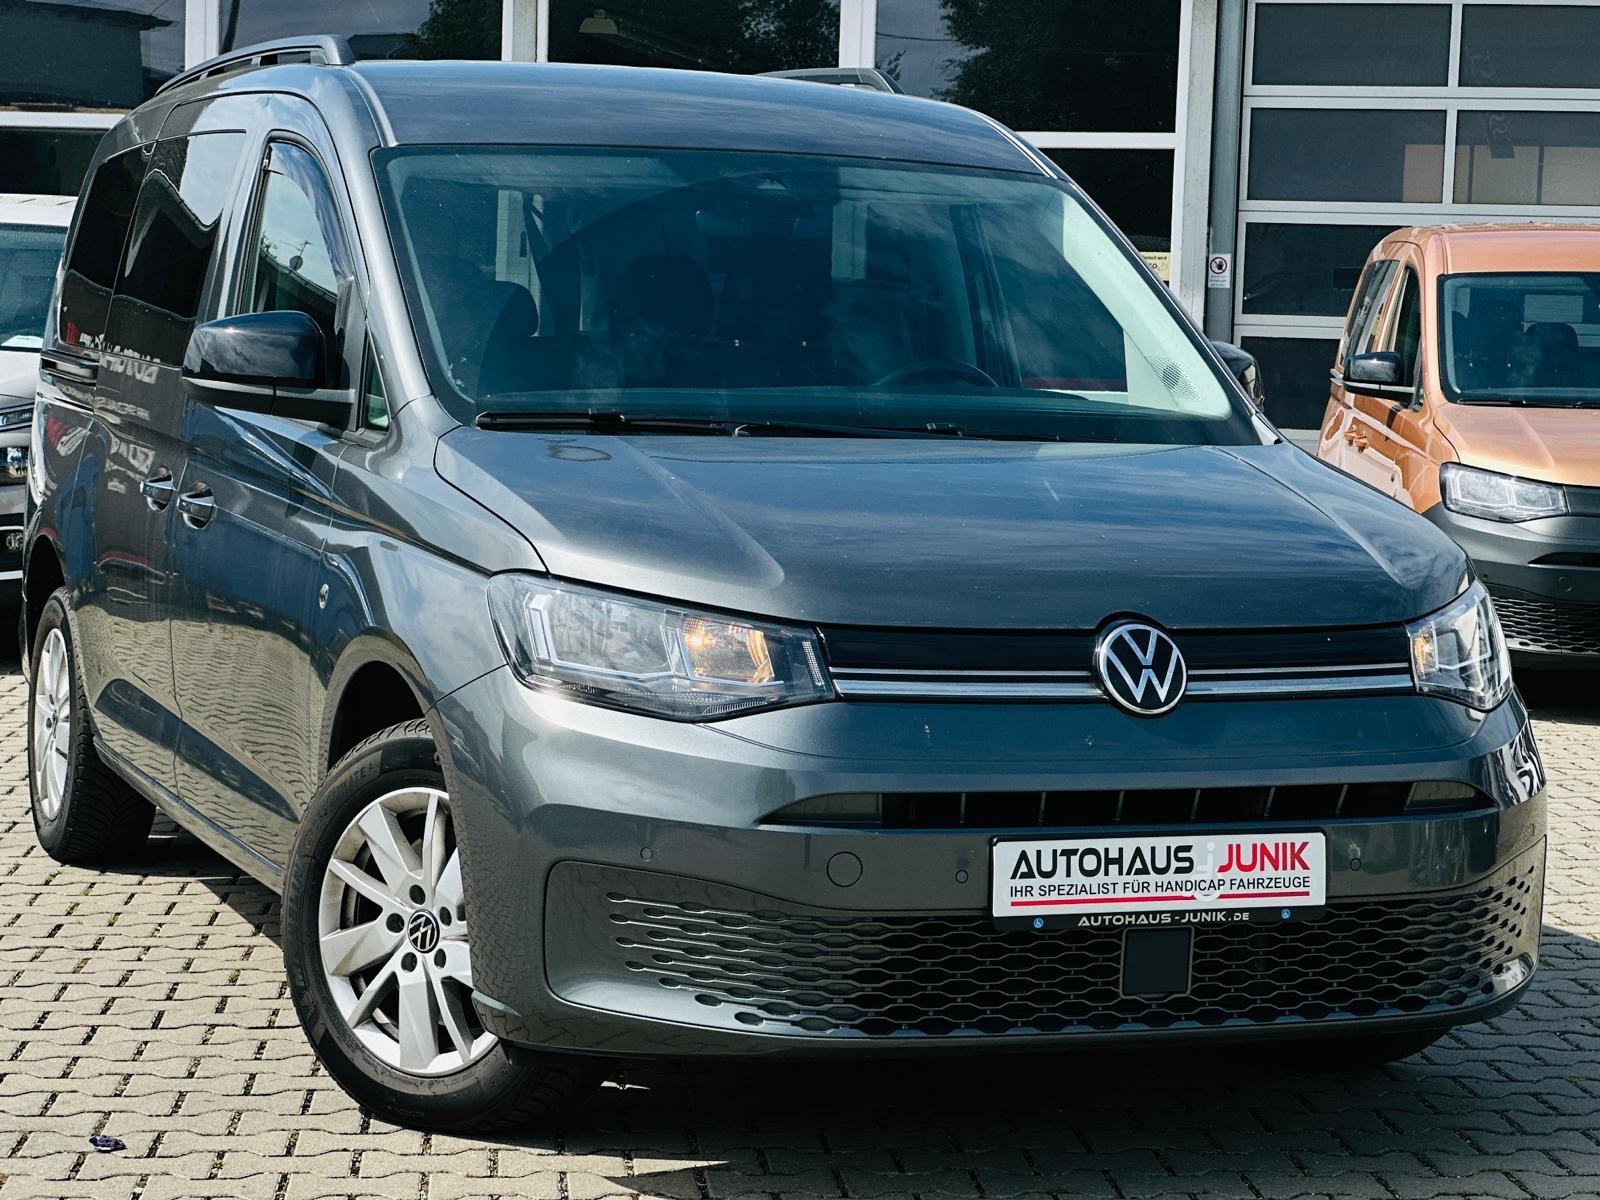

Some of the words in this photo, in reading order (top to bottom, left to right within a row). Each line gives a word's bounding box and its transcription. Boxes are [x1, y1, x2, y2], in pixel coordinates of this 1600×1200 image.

[1102, 625, 1183, 709] VW
[1009, 844, 1194, 880] AUTOHAUS
[1217, 841, 1311, 873] JUNIK
[1010, 885, 1034, 898] IHR
[1038, 882, 1118, 897] SPEZIALIST
[1123, 879, 1151, 894] FÜR
[1155, 879, 1226, 893] HANDICAP
[1230, 876, 1311, 891] FAHRZEUGE
